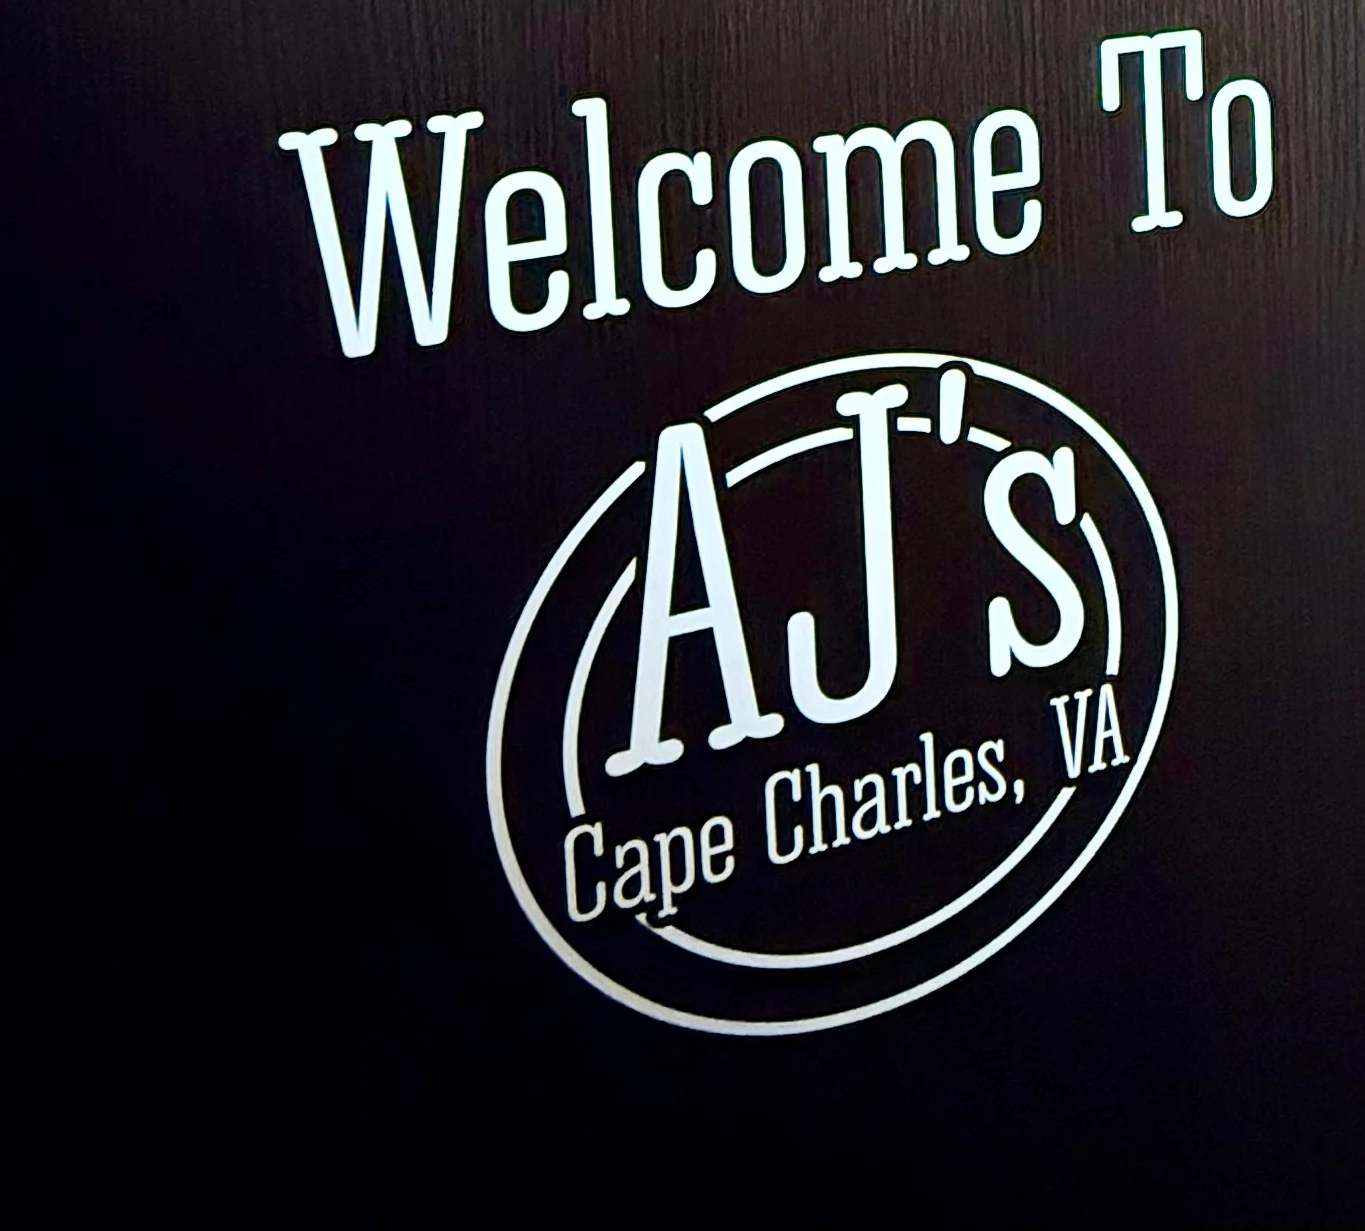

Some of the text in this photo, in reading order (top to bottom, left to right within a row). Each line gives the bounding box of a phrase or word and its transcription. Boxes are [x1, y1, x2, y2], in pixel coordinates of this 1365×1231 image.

[279, 28, 1275, 358] Welcome To
[605, 368, 1085, 777] AJ's
[563, 684, 1130, 923] Cape Charles, VA
